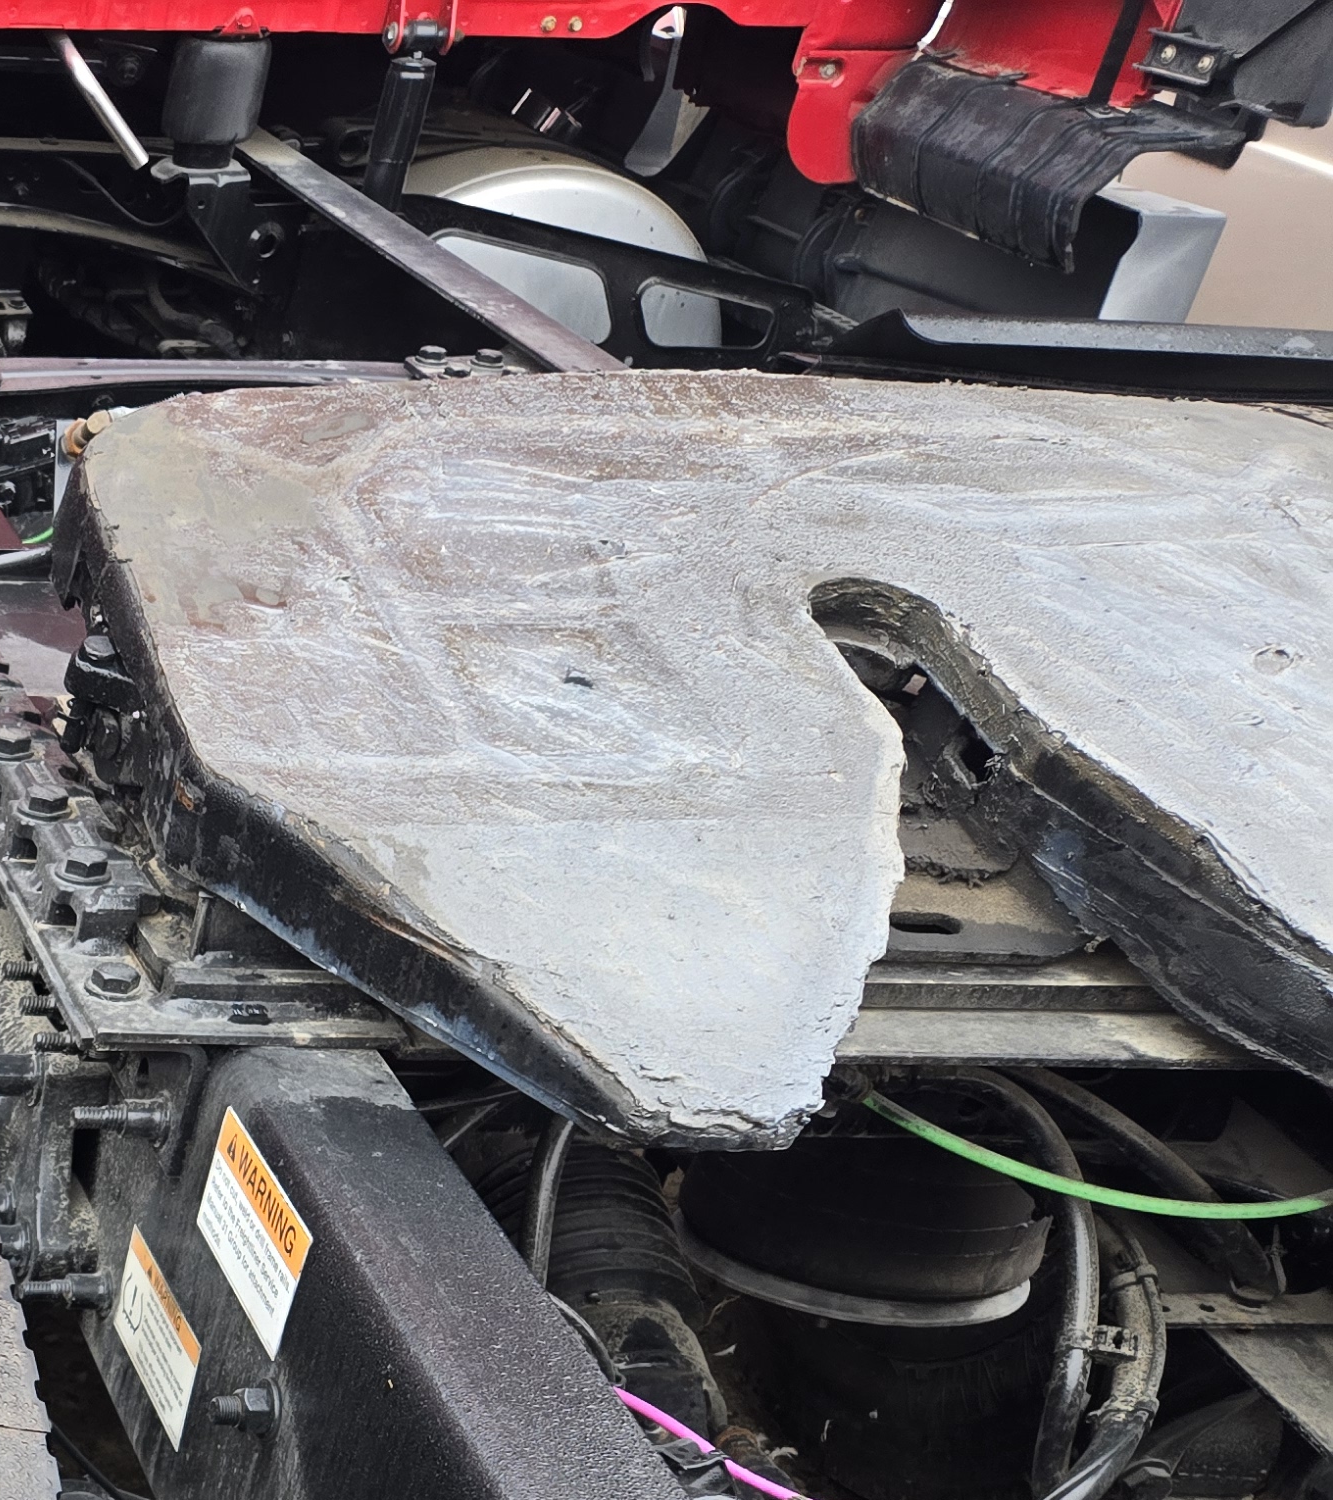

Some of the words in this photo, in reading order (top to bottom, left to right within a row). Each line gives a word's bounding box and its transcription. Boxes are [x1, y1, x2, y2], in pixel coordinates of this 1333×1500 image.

[236, 1144, 298, 1258] WARNING
[226, 1228, 243, 1262] Group
[263, 1241, 280, 1273] frame
[259, 1260, 280, 1300] Service
